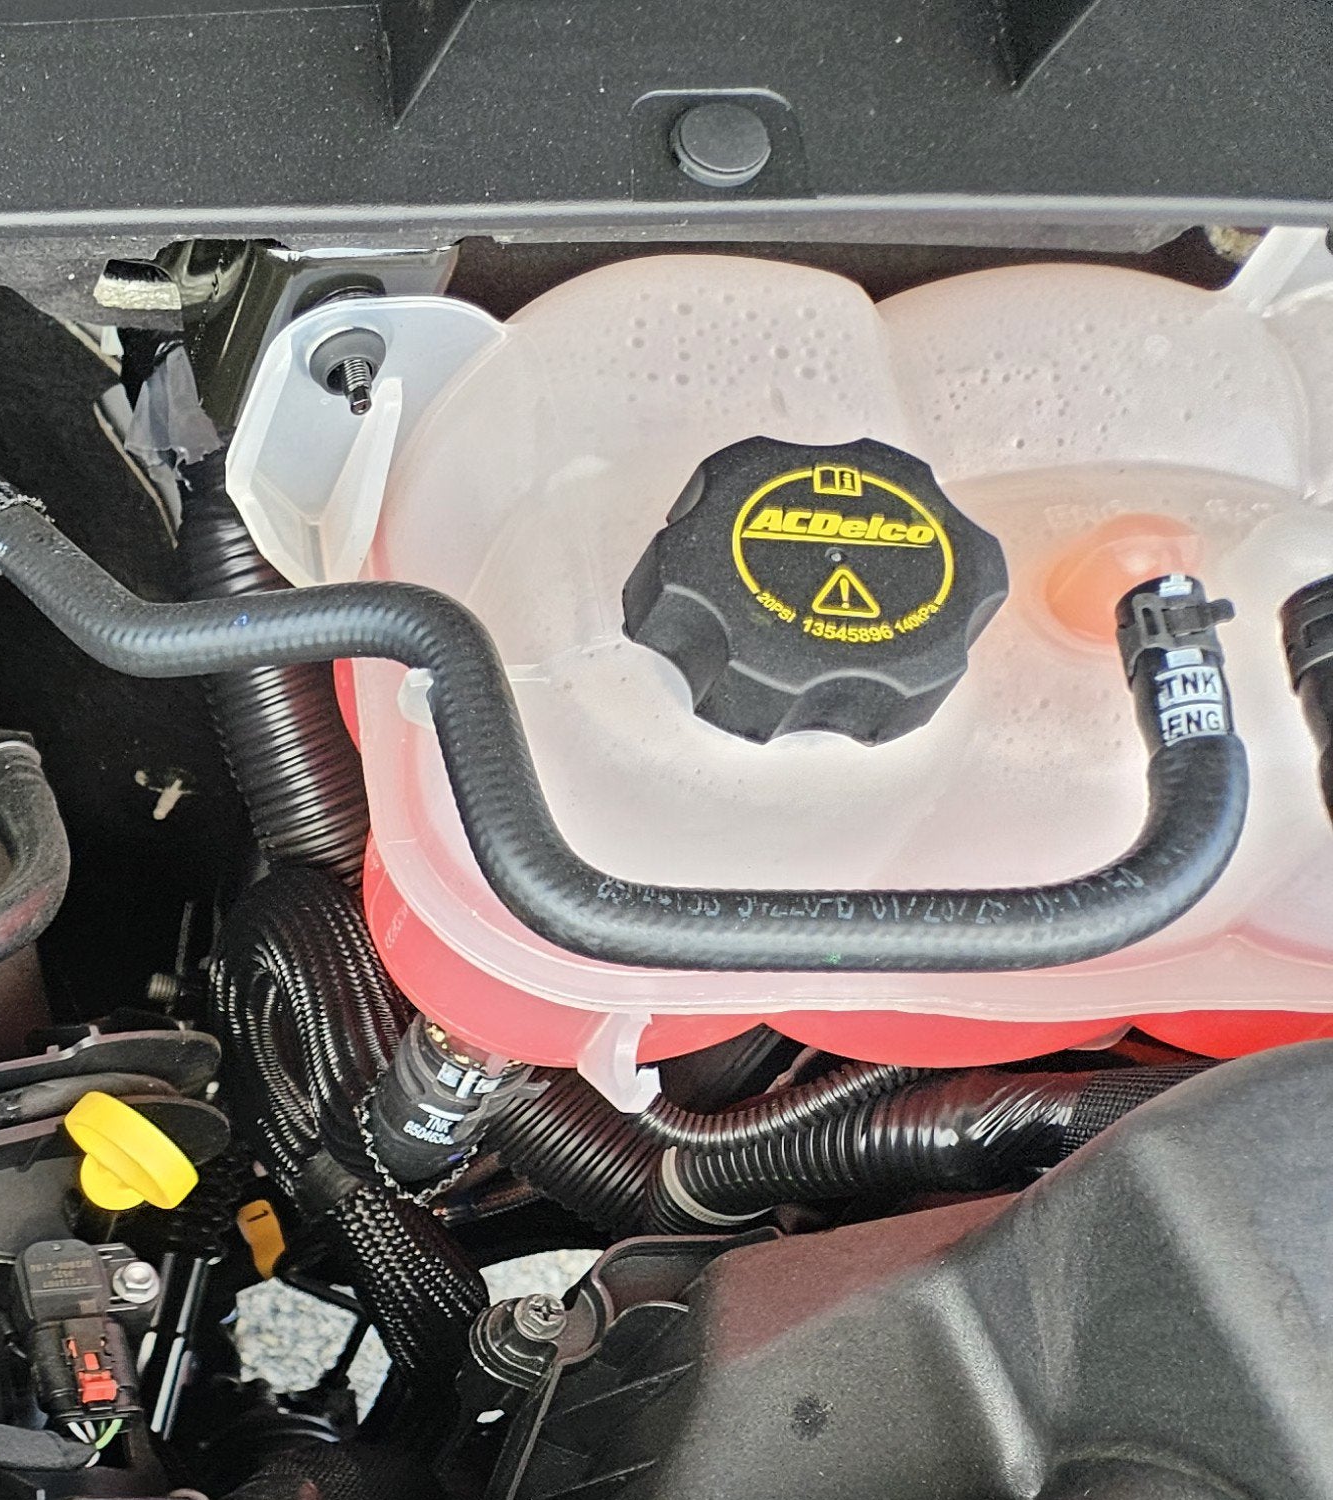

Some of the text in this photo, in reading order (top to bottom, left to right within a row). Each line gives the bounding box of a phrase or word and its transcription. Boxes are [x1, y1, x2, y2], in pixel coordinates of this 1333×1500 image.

[742, 508, 935, 547] ACDelco
[756, 592, 939, 643] 20PSI 13545896 140kPa
[425, 1114, 454, 1133] TNK
